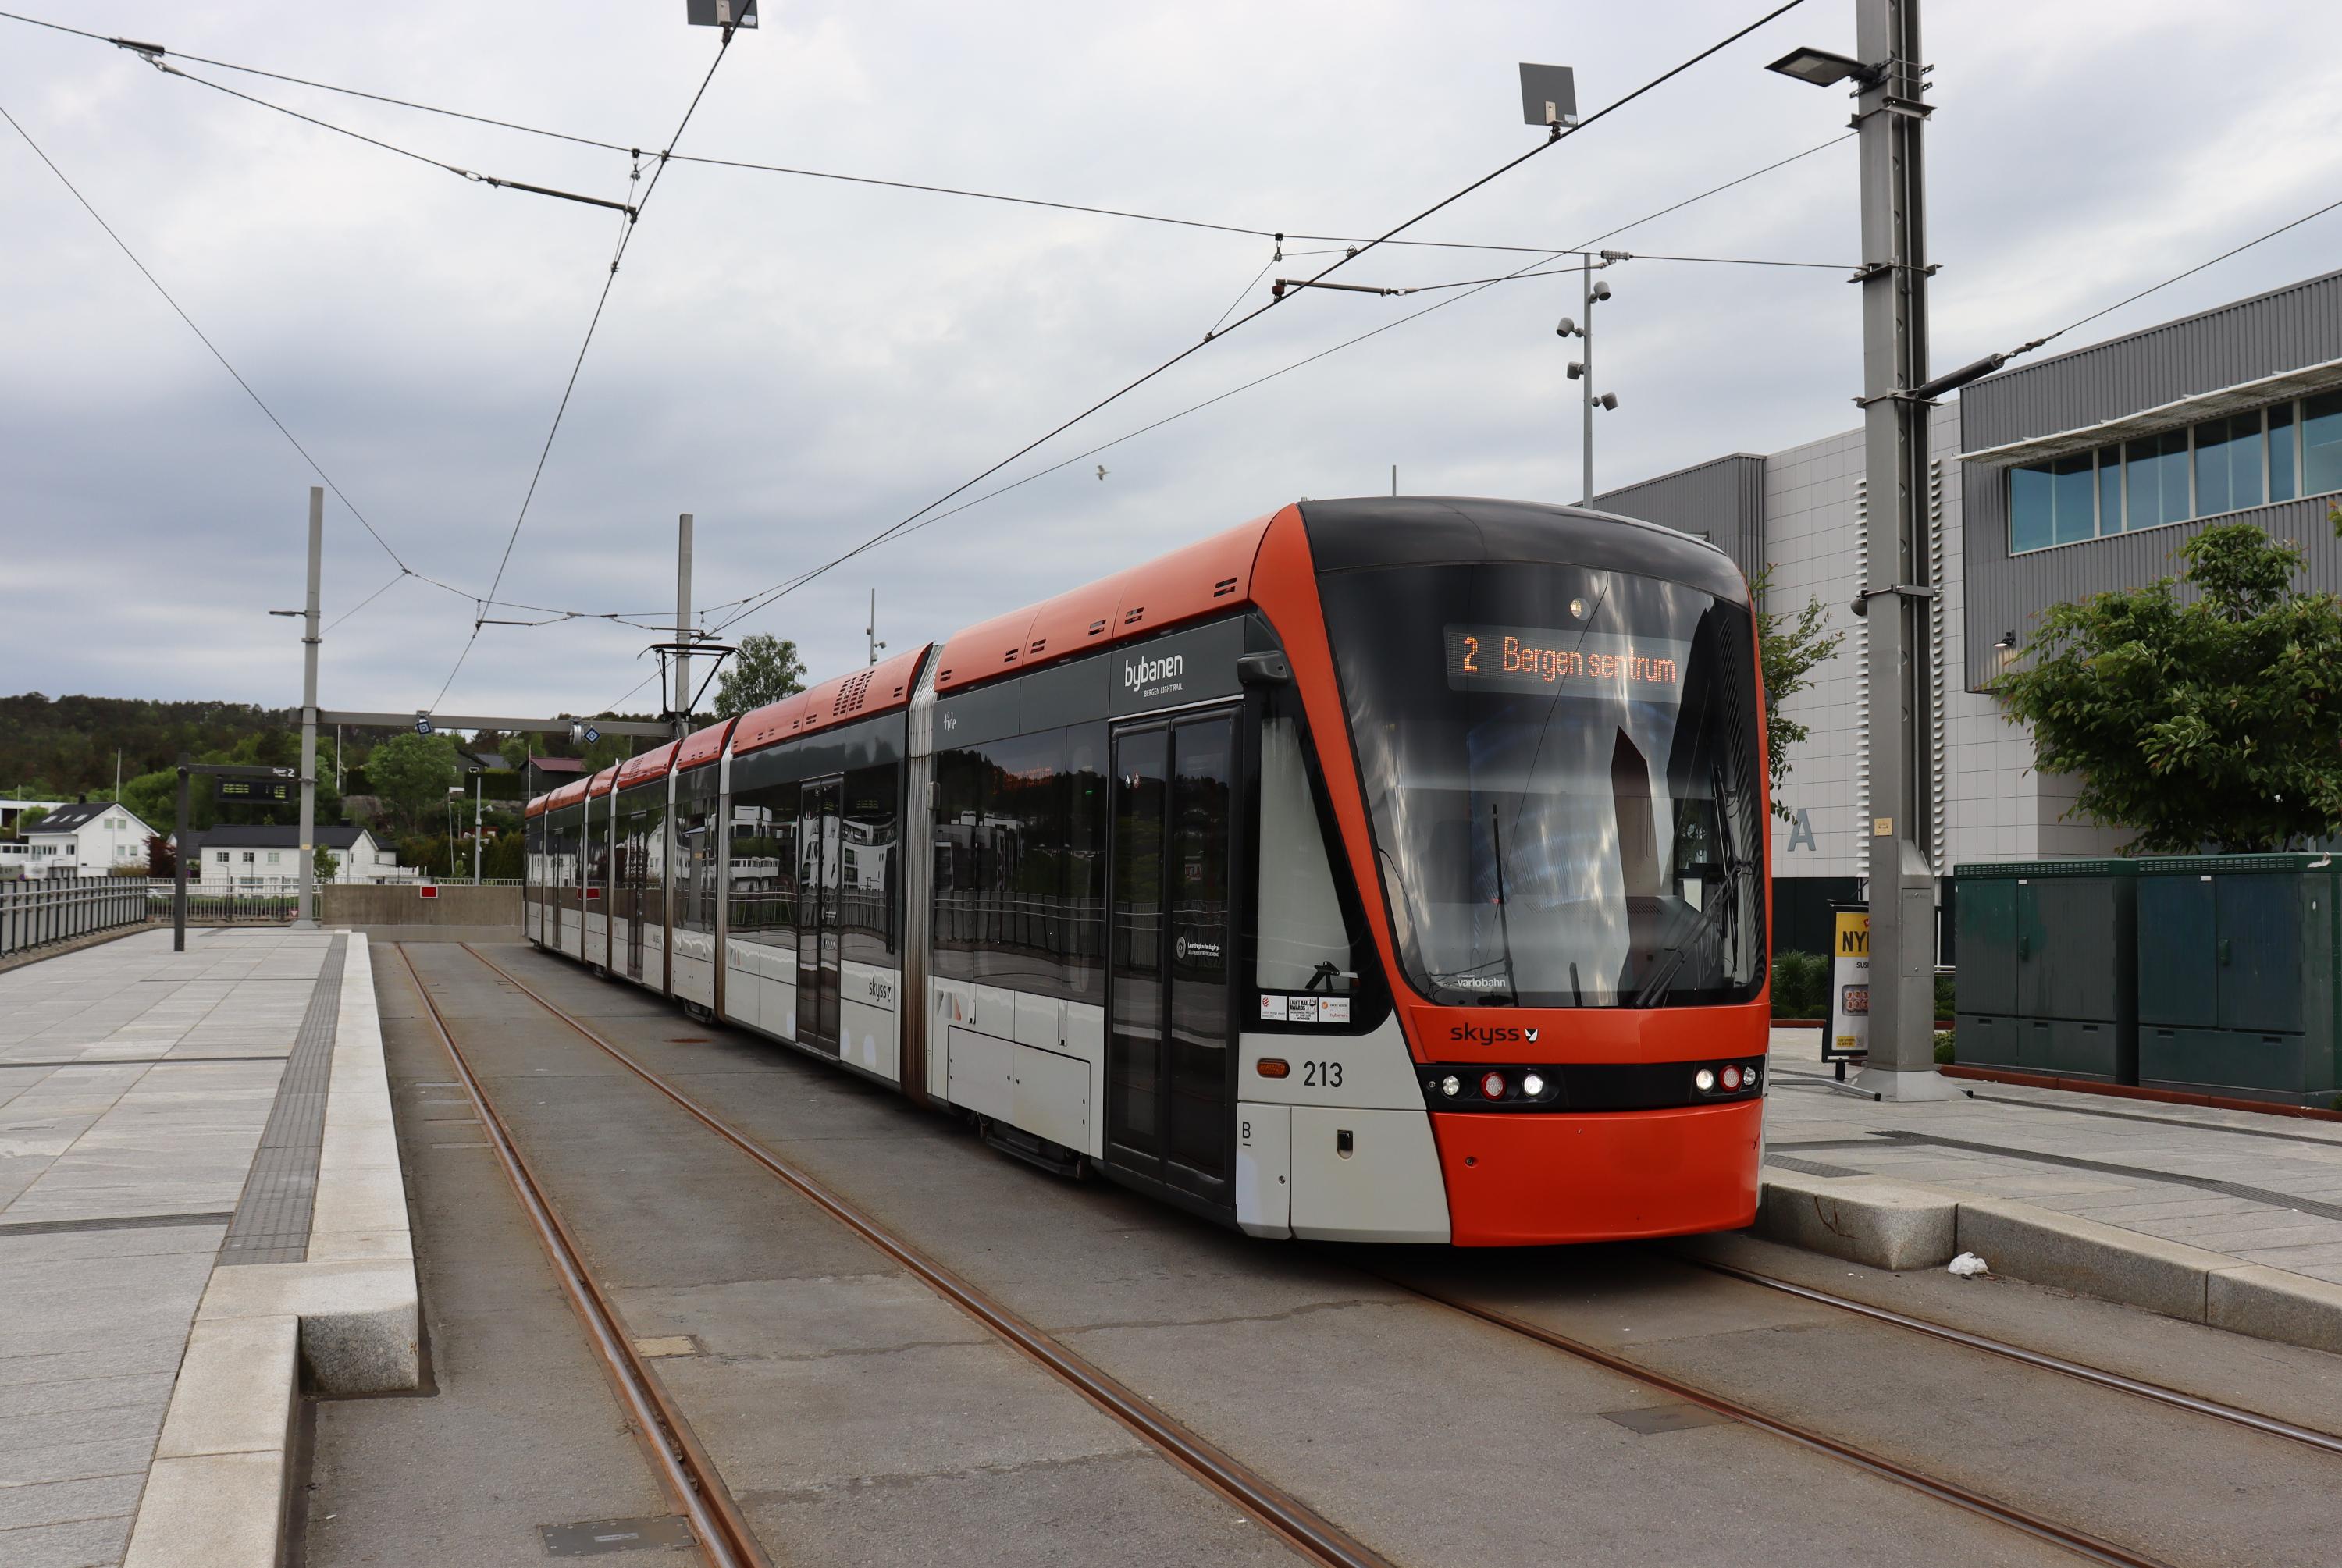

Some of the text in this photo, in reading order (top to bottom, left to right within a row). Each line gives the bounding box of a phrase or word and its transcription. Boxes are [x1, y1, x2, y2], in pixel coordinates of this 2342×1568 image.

[1464, 635, 1676, 684] 2 Bergen sentrum
[1124, 654, 1183, 692] bybanen
[1144, 683, 1183, 698] BERGEN LIGHT RAIL
[287, 768, 295, 777] 2
[1787, 808, 1817, 852] A
[869, 976, 887, 1002] skyss
[1457, 978, 1506, 987] variobahn
[1450, 1022, 1520, 1046] skyss
[1303, 1061, 1344, 1088] 213
[1242, 1121, 1251, 1139] B
